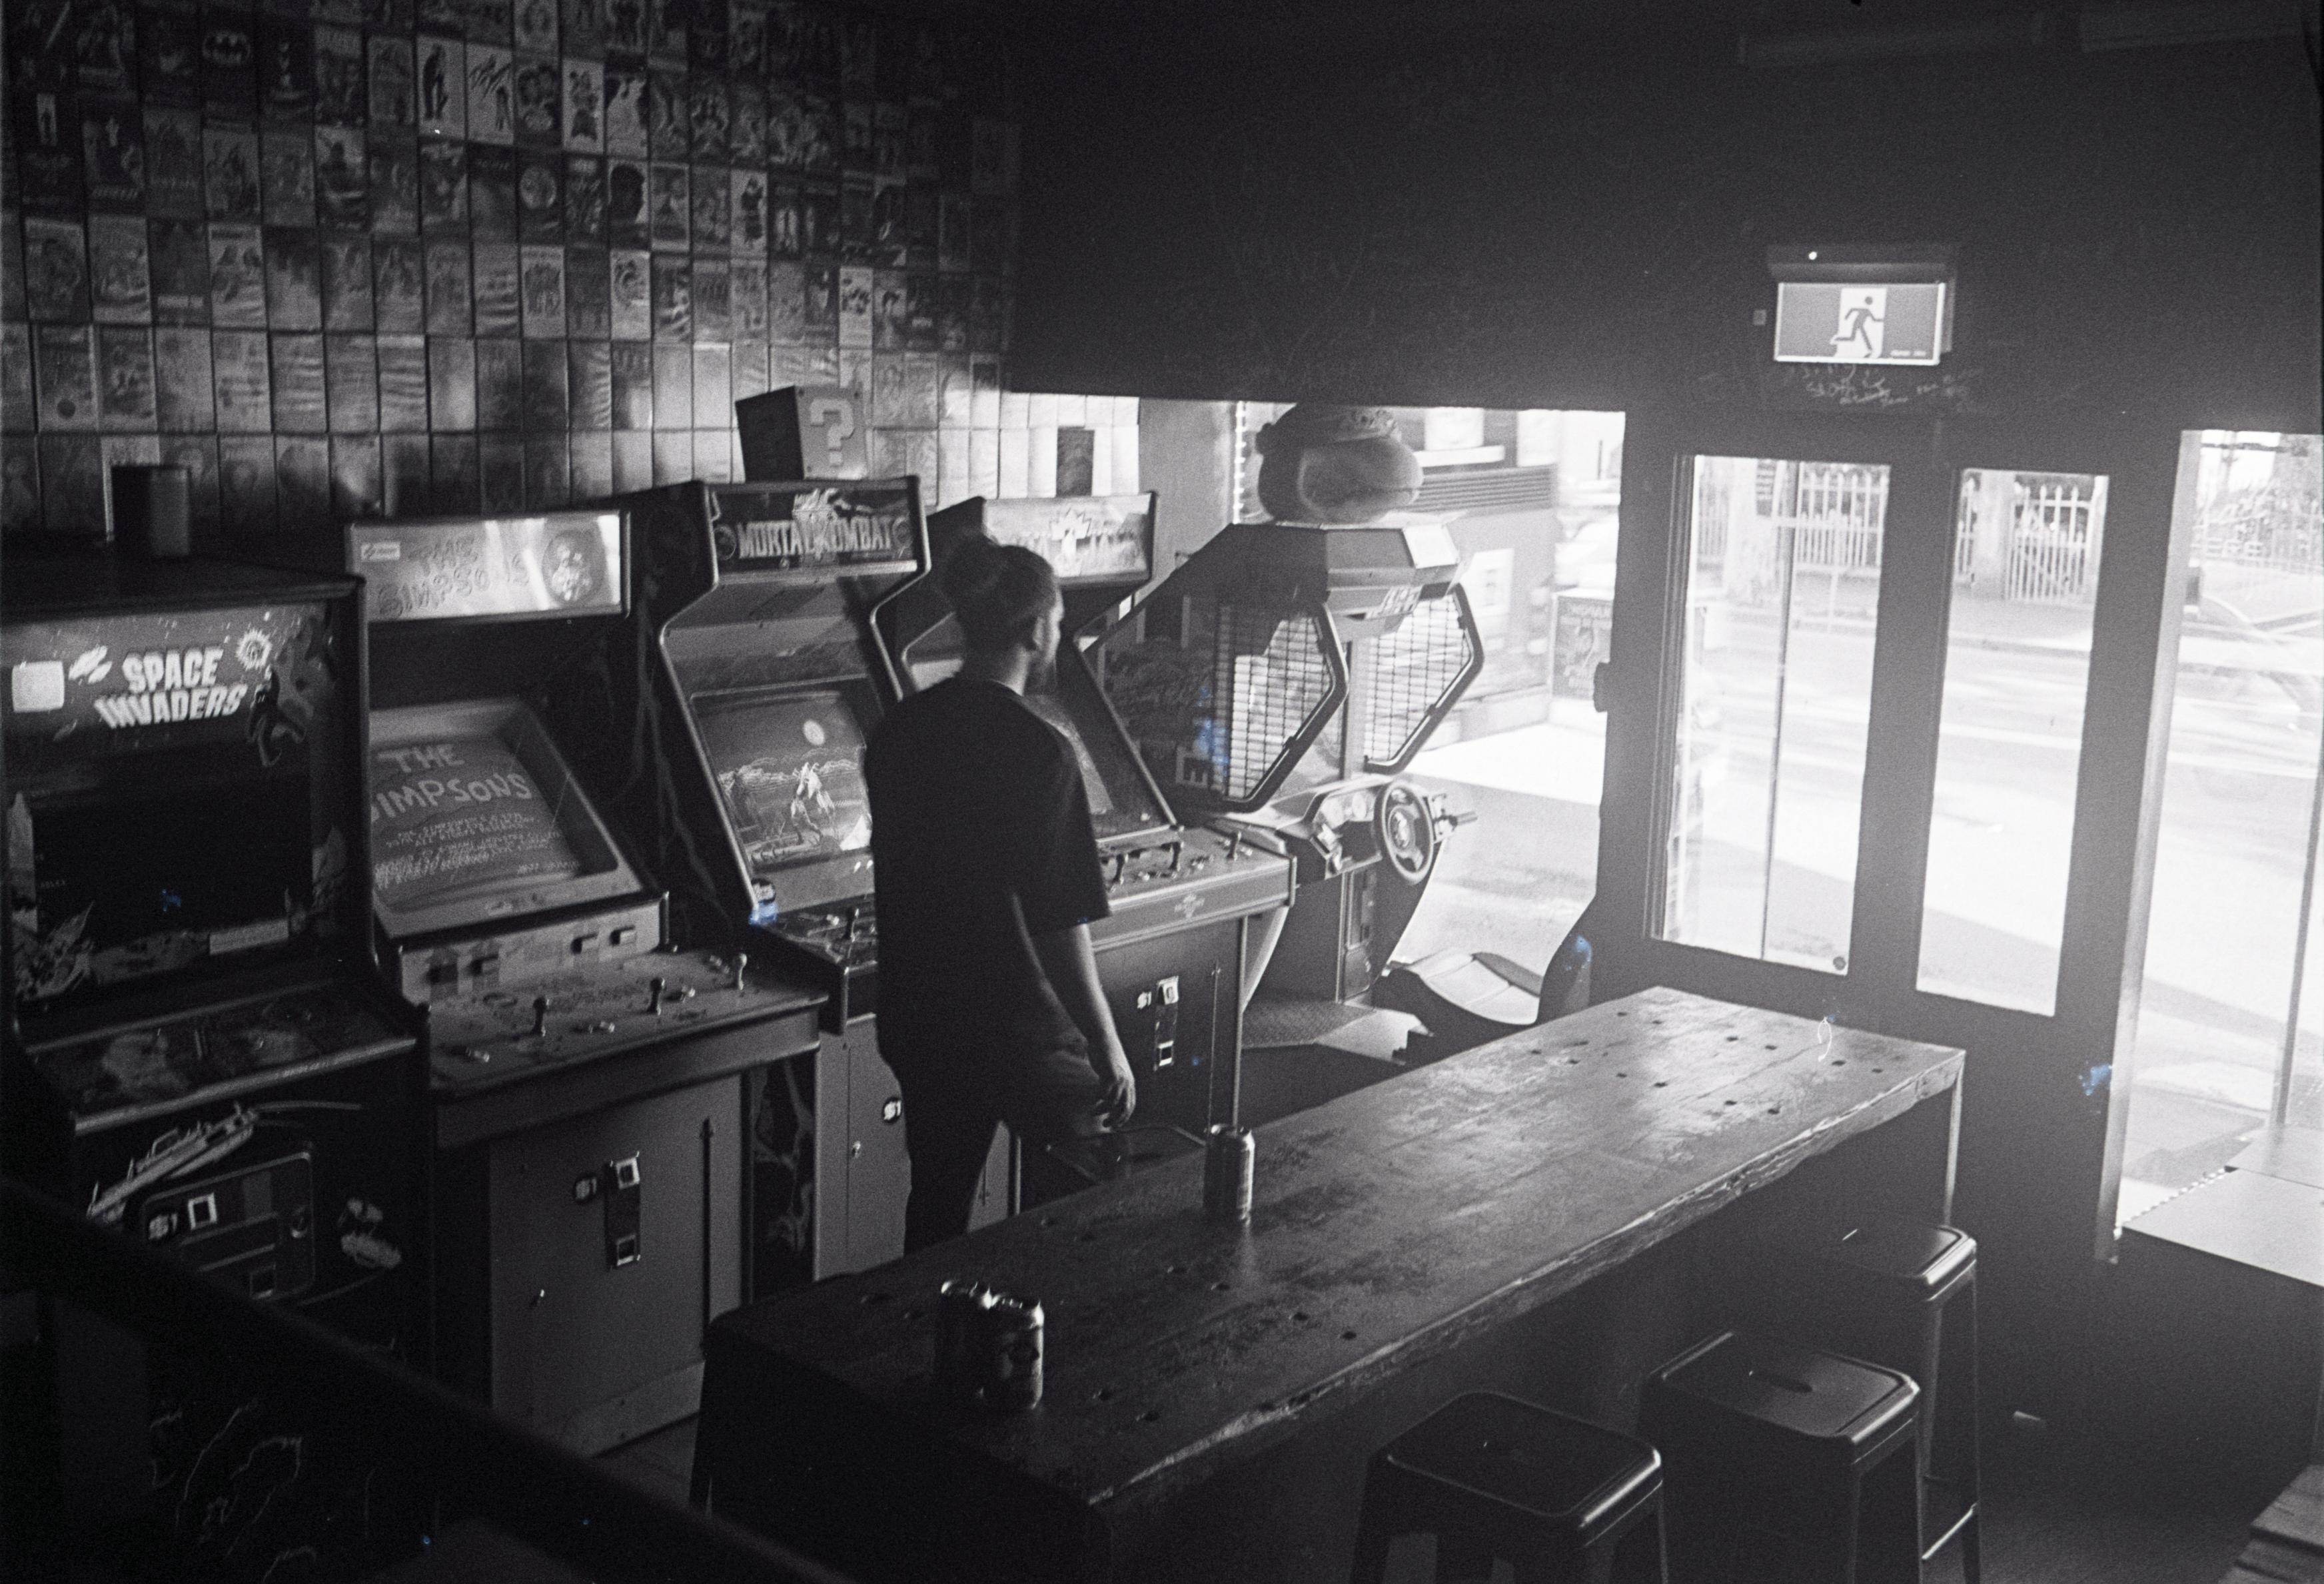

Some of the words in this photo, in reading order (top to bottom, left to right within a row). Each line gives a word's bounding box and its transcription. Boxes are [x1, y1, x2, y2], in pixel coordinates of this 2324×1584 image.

[408, 538, 479, 576] THE
[737, 520, 816, 559] MORTAL
[815, 516, 893, 560] KOMBAT
[122, 647, 224, 693] SPACE
[95, 685, 247, 729] INVADERS
[377, 745, 465, 773] THE
